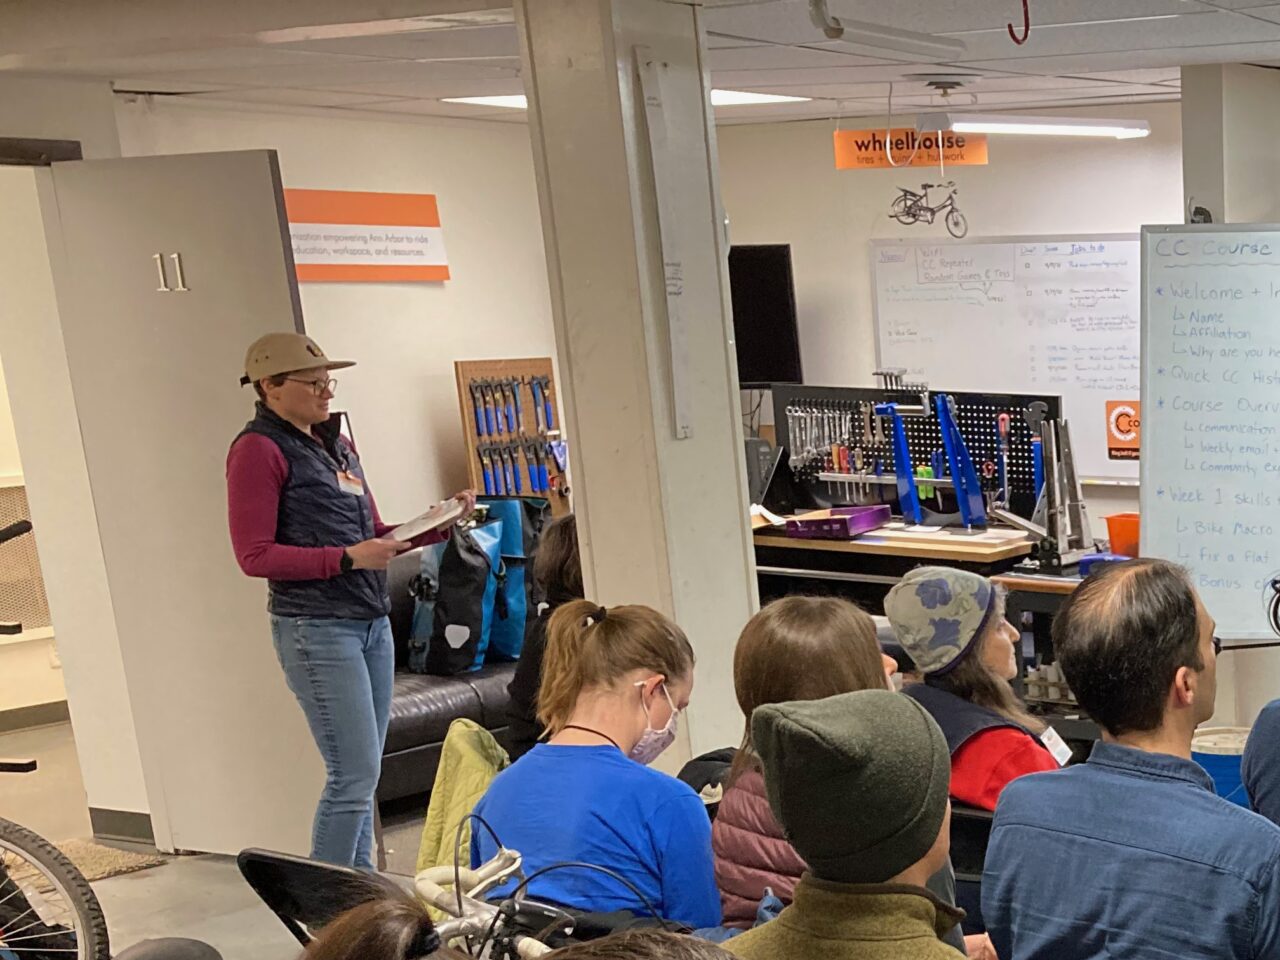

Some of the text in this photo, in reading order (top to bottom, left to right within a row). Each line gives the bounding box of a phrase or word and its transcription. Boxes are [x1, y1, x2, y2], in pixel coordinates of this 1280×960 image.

[855, 131, 965, 152] wheelhouse
[1155, 238, 1190, 257] CC
[1202, 240, 1273, 256] Course
[1170, 282, 1243, 300] Welcome
[1188, 309, 1225, 324] Name
[1189, 345, 1214, 361] Why
[1219, 348, 1238, 357] are
[1243, 348, 1263, 360] you
[1171, 366, 1211, 383] Quick
[1172, 396, 1224, 412] Course
[1169, 486, 1202, 502] Week
[1195, 520, 1224, 535] Bike
